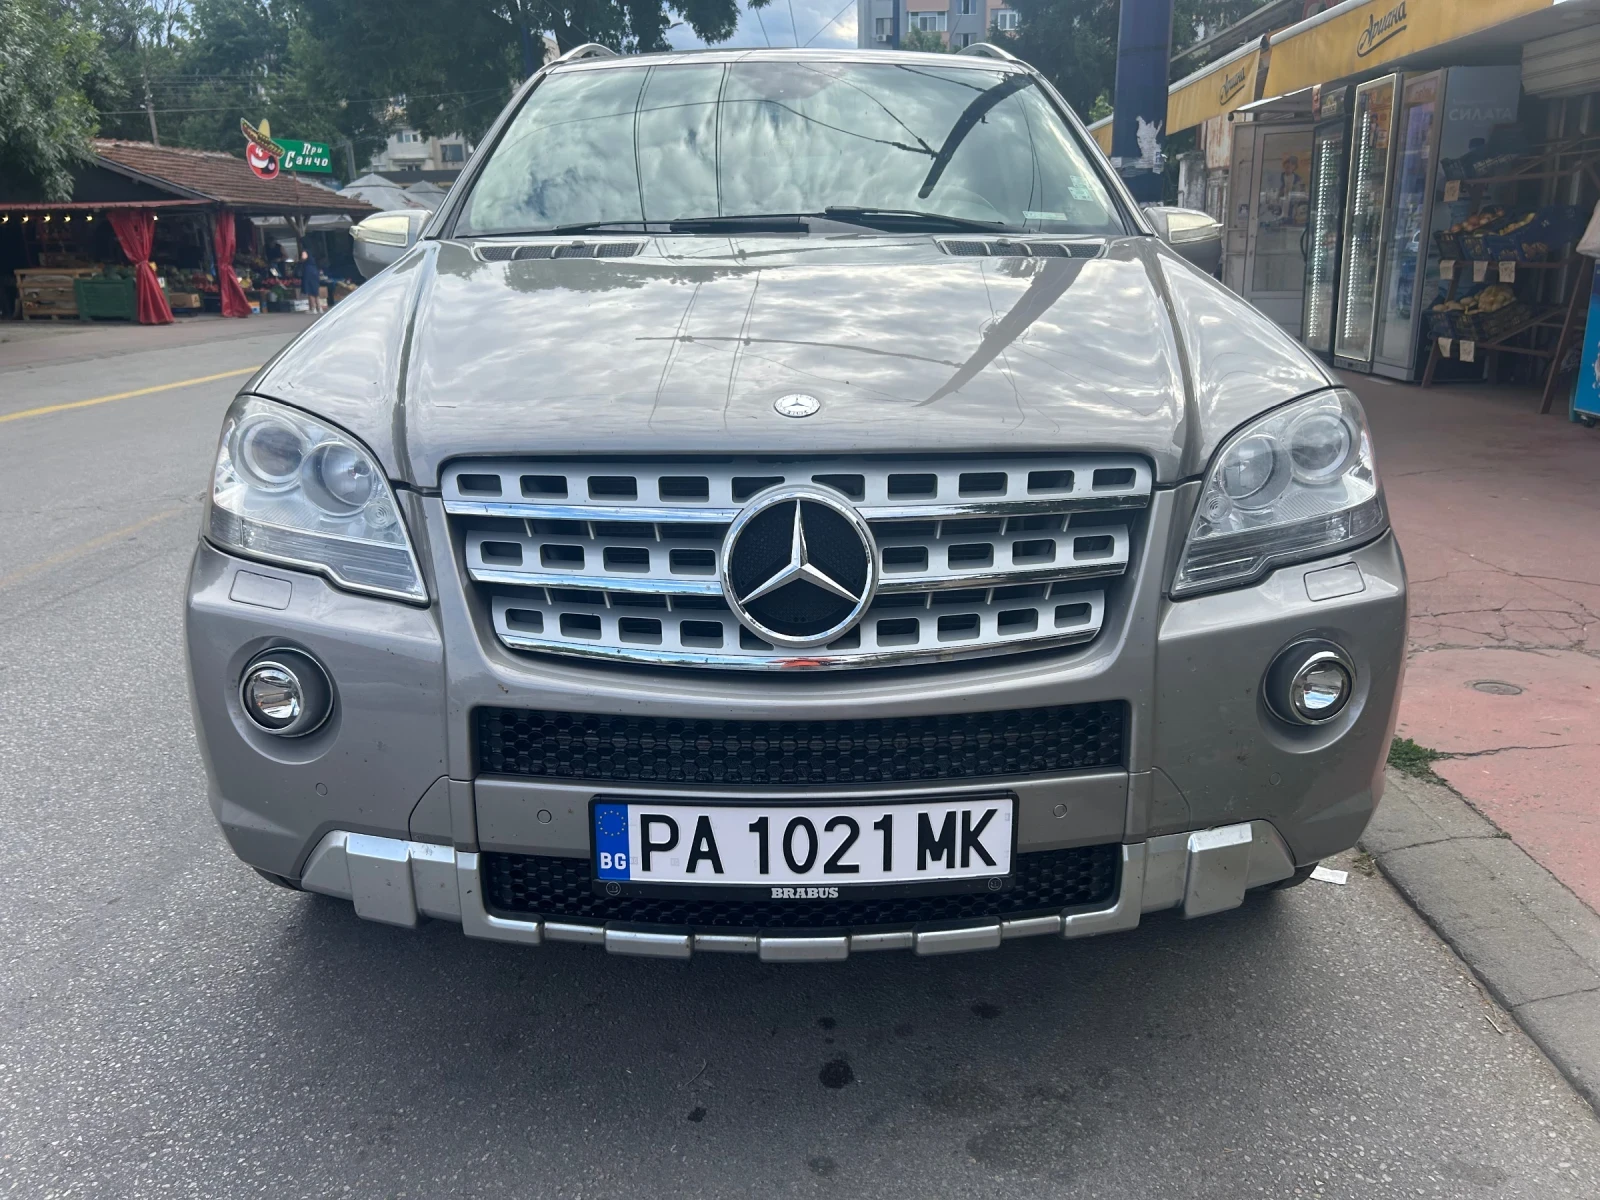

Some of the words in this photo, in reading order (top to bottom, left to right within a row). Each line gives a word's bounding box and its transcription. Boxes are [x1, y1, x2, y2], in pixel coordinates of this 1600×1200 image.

[1357, 1, 1407, 56] Ариана
[302, 143, 323, 156] При
[284, 151, 329, 169] Санчо
[639, 813, 725, 875] PA
[748, 813, 893, 876] 1021
[916, 808, 998, 872] MK
[599, 852, 627, 870] BG
[771, 887, 839, 899] BRABUS
